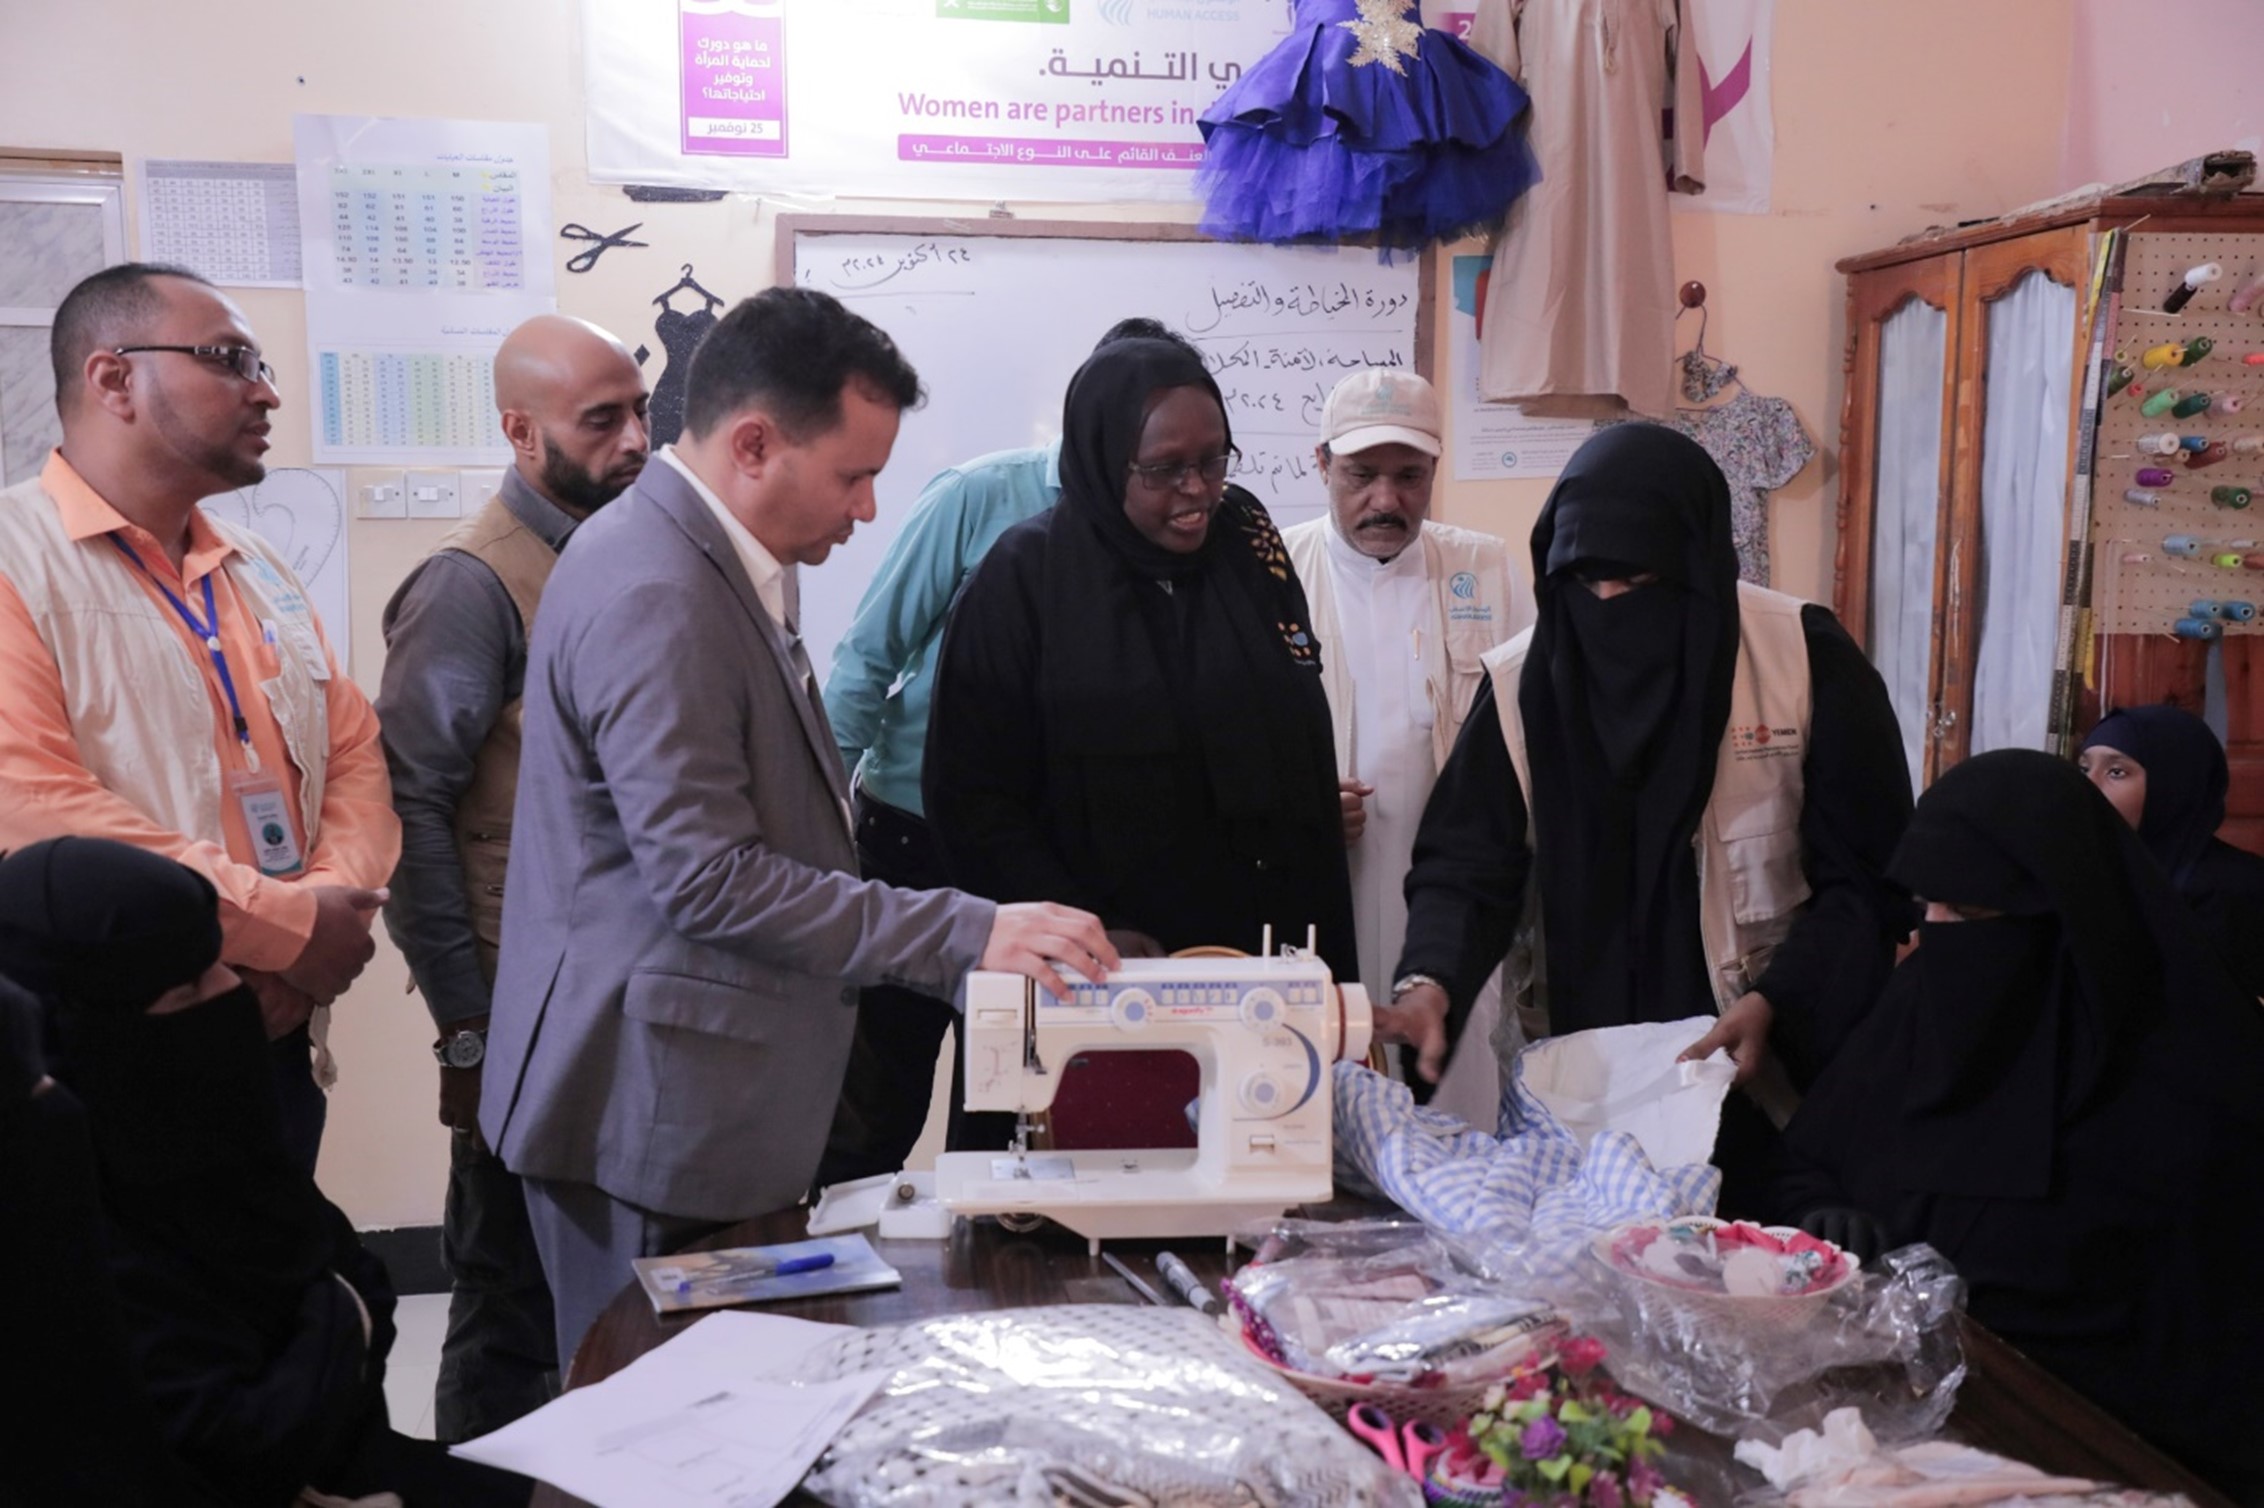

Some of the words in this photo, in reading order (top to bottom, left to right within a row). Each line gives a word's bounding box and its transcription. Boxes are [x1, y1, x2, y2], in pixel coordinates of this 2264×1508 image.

[1147, 8, 1191, 20] HUMAN
[1194, 9, 1240, 22] ACCESS
[697, 37, 730, 51] دورك
[733, 40, 752, 53] هو
[754, 40, 768, 52] ما
[695, 53, 729, 68] المرأة
[732, 56, 771, 69] لحماية
[713, 72, 754, 86] وتوفير
[898, 92, 1000, 119] Women
[1007, 100, 1048, 121] are
[1055, 99, 1164, 128] partners
[1172, 101, 1194, 125] in
[707, 121, 747, 135] نوفمبر
[750, 122, 763, 134] 25
[1016, 144, 1072, 162] النوع
[1075, 145, 1112, 160] على
[1117, 147, 1158, 164] القائم
[1287, 281, 1360, 320] الخياطة
[1365, 289, 1408, 319] دورة
[1771, 728, 1798, 737] YEMEN
